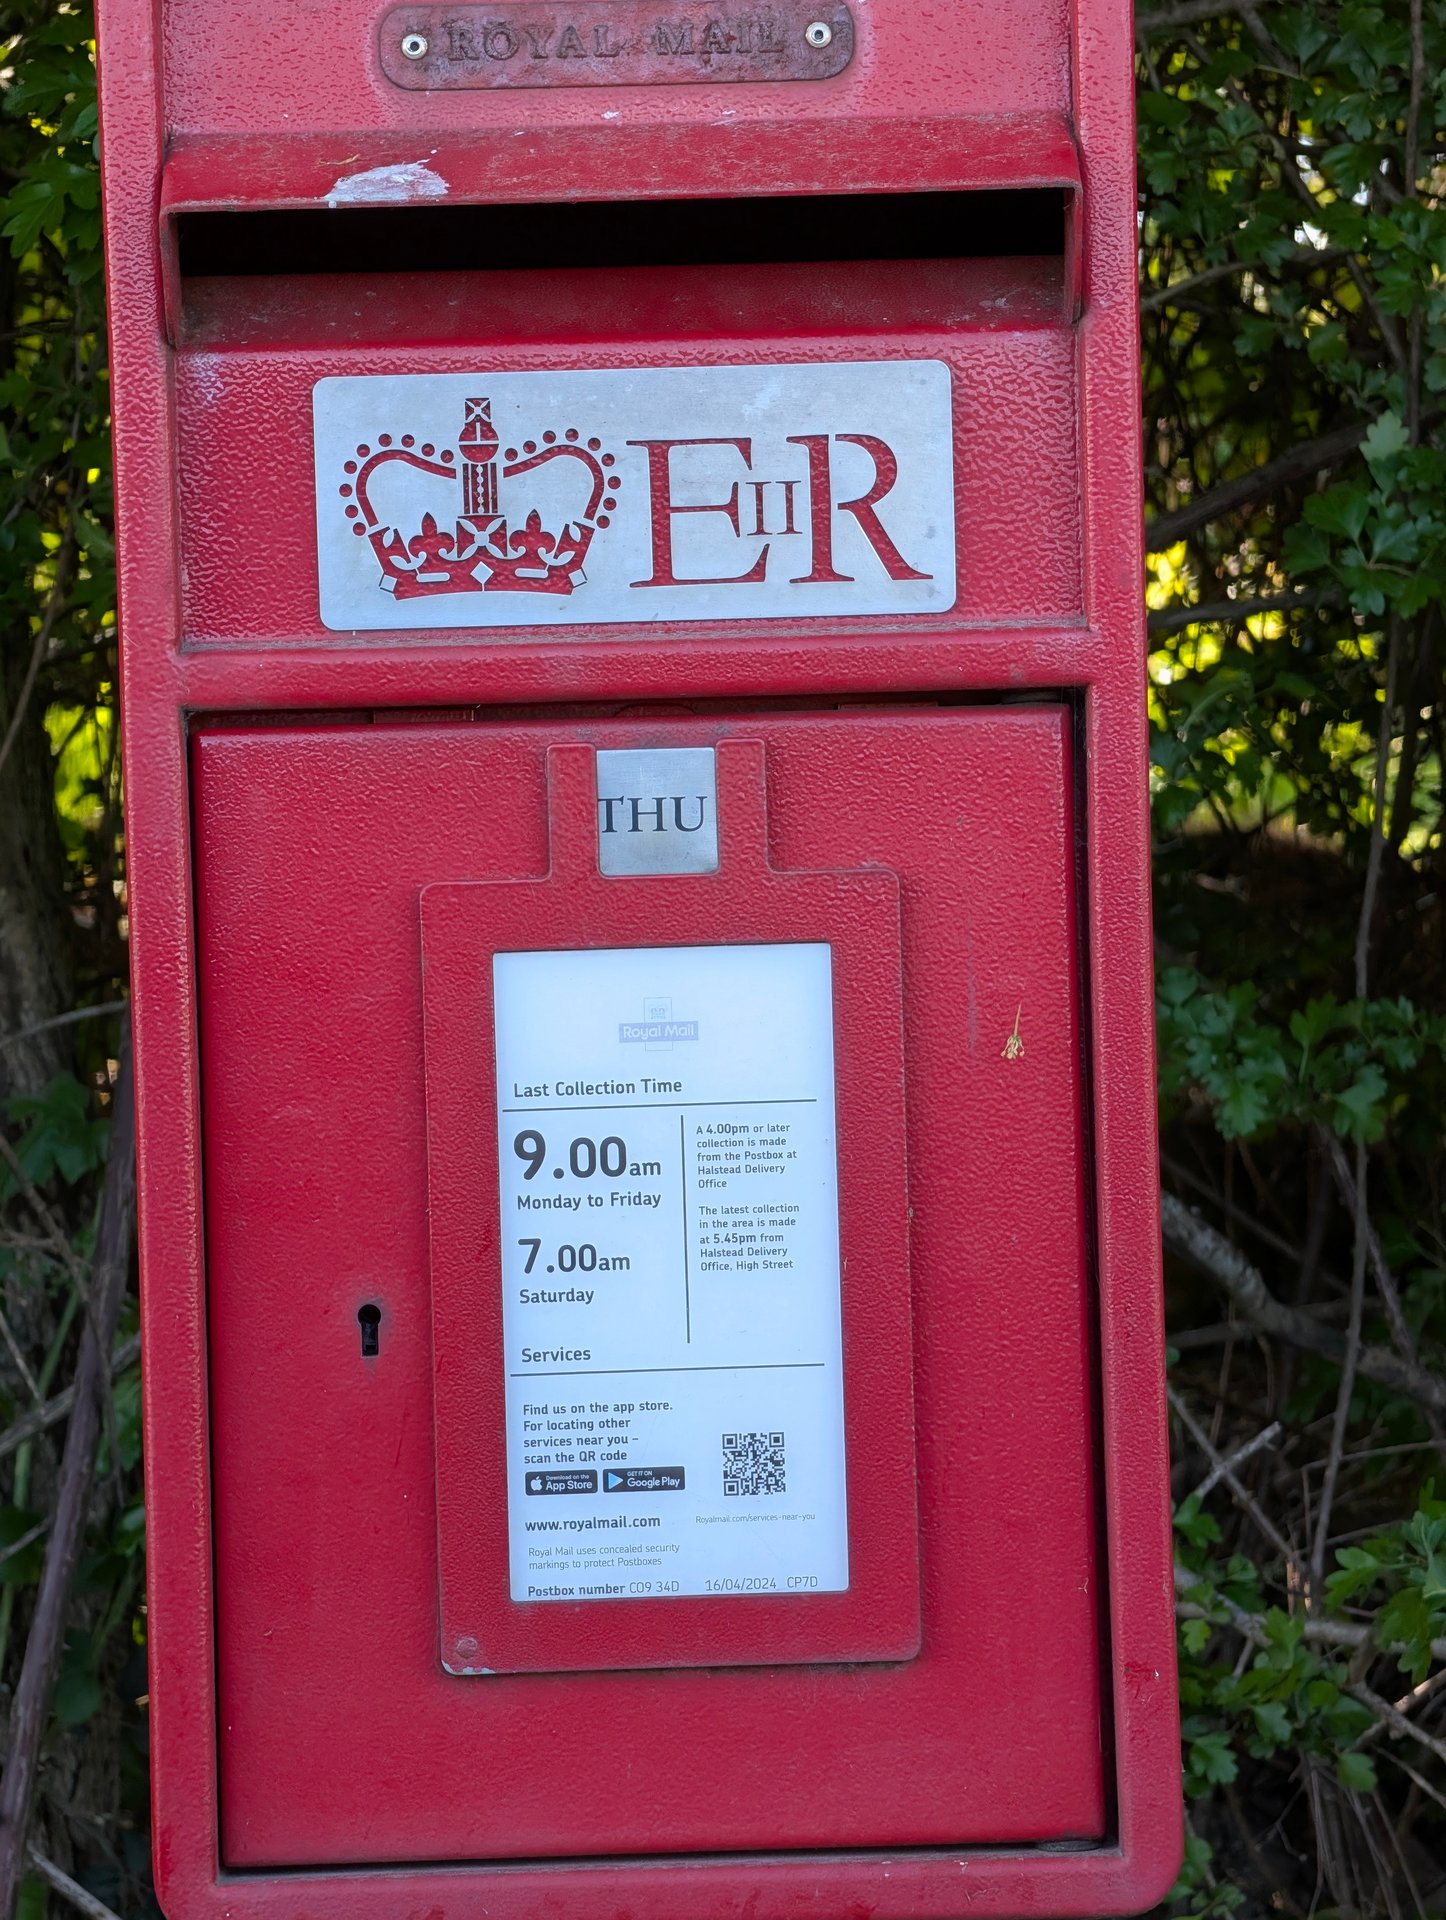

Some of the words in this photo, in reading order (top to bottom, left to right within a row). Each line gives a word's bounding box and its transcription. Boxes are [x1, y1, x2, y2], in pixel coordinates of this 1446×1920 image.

[448, 24, 621, 62] ROYAL
[657, 20, 784, 56] MAIL
[599, 795, 708, 834] THU
[623, 1025, 661, 1040] Royal
[665, 1024, 694, 1037] Mail
[514, 1083, 549, 1097] Last
[556, 1080, 635, 1096] Collection
[640, 1078, 682, 1093] Time
[696, 1126, 703, 1134] A
[706, 1123, 749, 1136] 4.00pm
[767, 1124, 790, 1132] later
[697, 1138, 743, 1148] collection
[747, 1137, 756, 1146] is
[759, 1137, 786, 1146] made
[697, 1153, 721, 1161] from
[725, 1152, 740, 1160] the
[745, 1151, 783, 1160] Postbox
[698, 1165, 741, 1175] Halstead
[745, 1164, 785, 1174] Delivery
[698, 1179, 727, 1188] Office
[518, 1194, 581, 1211] Monday
[587, 1194, 603, 1207] to
[611, 1191, 661, 1208] Friday
[699, 1206, 717, 1215] The
[721, 1206, 749, 1214] latest
[753, 1203, 799, 1213] collection
[700, 1219, 708, 1228] in
[712, 1219, 728, 1228] the
[757, 1218, 765, 1227] is
[769, 1217, 796, 1226] made
[700, 1236, 710, 1244] at
[714, 1233, 756, 1245] 5.45pm
[760, 1233, 783, 1242] from
[701, 1248, 743, 1257] Halstead
[748, 1247, 787, 1257] Delivery
[701, 1262, 732, 1271] Office,
[737, 1261, 759, 1271] High
[763, 1260, 793, 1269] Street
[520, 1288, 594, 1304] Saturday
[522, 1347, 591, 1362] Services
[524, 1404, 548, 1415] Find
[553, 1406, 566, 1414] us
[571, 1405, 585, 1413] on
[590, 1402, 608, 1413] the
[613, 1404, 634, 1414] app
[639, 1401, 672, 1411] store.
[524, 1421, 543, 1431] For
[547, 1419, 594, 1431] locating
[599, 1418, 631, 1428] other
[524, 1436, 572, 1447] services
[576, 1437, 604, 1445] near
[607, 1436, 628, 1447] you
[524, 1455, 551, 1464] scan
[555, 1452, 574, 1462] the
[579, 1451, 595, 1462] QR
[600, 1450, 627, 1461] code
[546, 1481, 565, 1492] App
[567, 1480, 593, 1490] Store
[627, 1477, 661, 1489] Google
[661, 1477, 680, 1488] Play
[525, 1515, 660, 1532] www.royalmail.com
[695, 1513, 816, 1525] Royalmail.com/services-near-you
[529, 1546, 552, 1558] Royal
[555, 1546, 573, 1556] Mail
[599, 1544, 642, 1555] concealed
[645, 1543, 680, 1555] security
[529, 1560, 570, 1570] markings
[572, 1560, 581, 1568] to
[584, 1558, 615, 1570] protect
[618, 1556, 662, 1566] Postboxes
[705, 1578, 776, 1591] 16/04/2024
[787, 1576, 817, 1588] CP7D
[528, 1586, 574, 1597] Postbox
[579, 1584, 625, 1595] number
[656, 1581, 679, 1592] 34D
